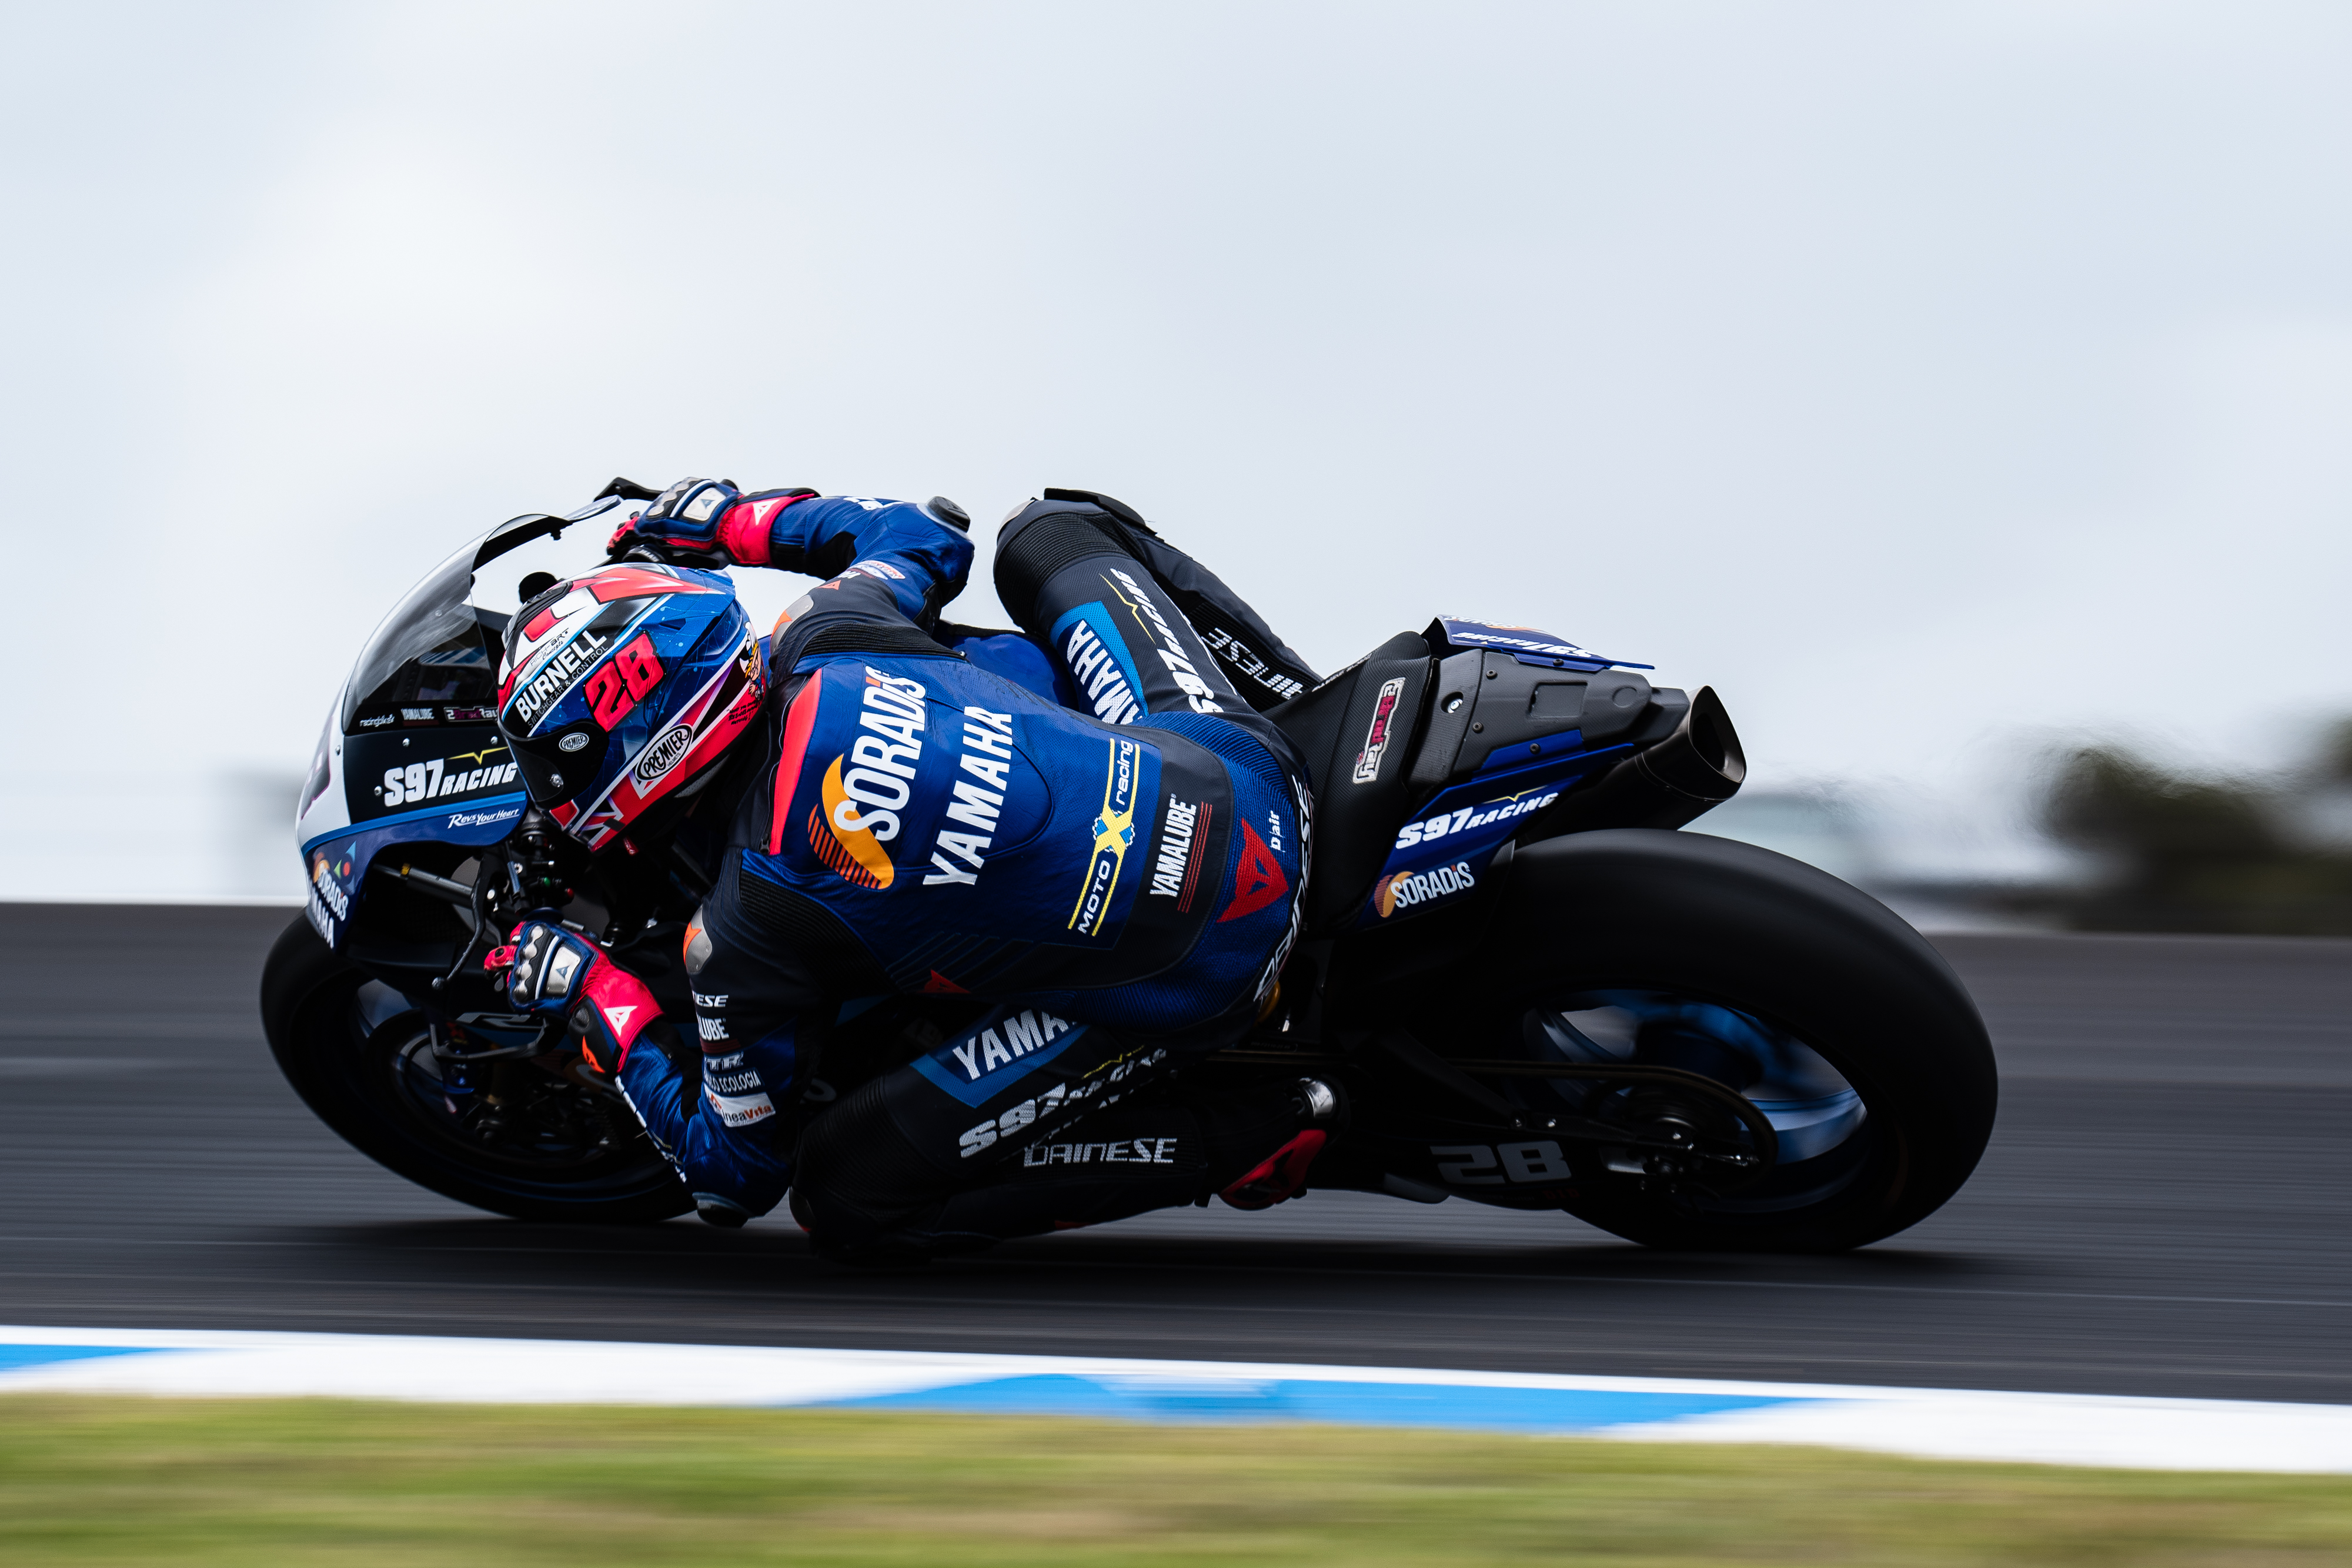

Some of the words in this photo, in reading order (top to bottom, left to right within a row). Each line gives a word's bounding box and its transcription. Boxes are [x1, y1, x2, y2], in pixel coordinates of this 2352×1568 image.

[516, 630, 607, 723] BURNELL
[527, 685, 565, 728] SWITCHGEAR
[572, 646, 609, 680] CONTROL
[585, 633, 666, 733] 28
[1067, 619, 1144, 725] AMAHA
[383, 758, 445, 807] S97
[439, 762, 518, 797] RACING
[643, 730, 687, 777] PREMIER
[923, 706, 1013, 885] YAMAHA
[1395, 807, 1474, 850] S97
[1466, 792, 1559, 829] RACING
[1077, 860, 1111, 934] MOTO
[1115, 740, 1134, 806] racing
[1150, 800, 1197, 897] YAMALUBE
[692, 991, 729, 1008] NESE
[697, 1015, 730, 1041] LUBE
[953, 1009, 1077, 1081] YAMA
[719, 1070, 761, 1093] ECOLOGIA
[958, 1082, 1066, 1159] S97
[1023, 1137, 1178, 1168] DAINESE
[1429, 1139, 1572, 1185] 28
